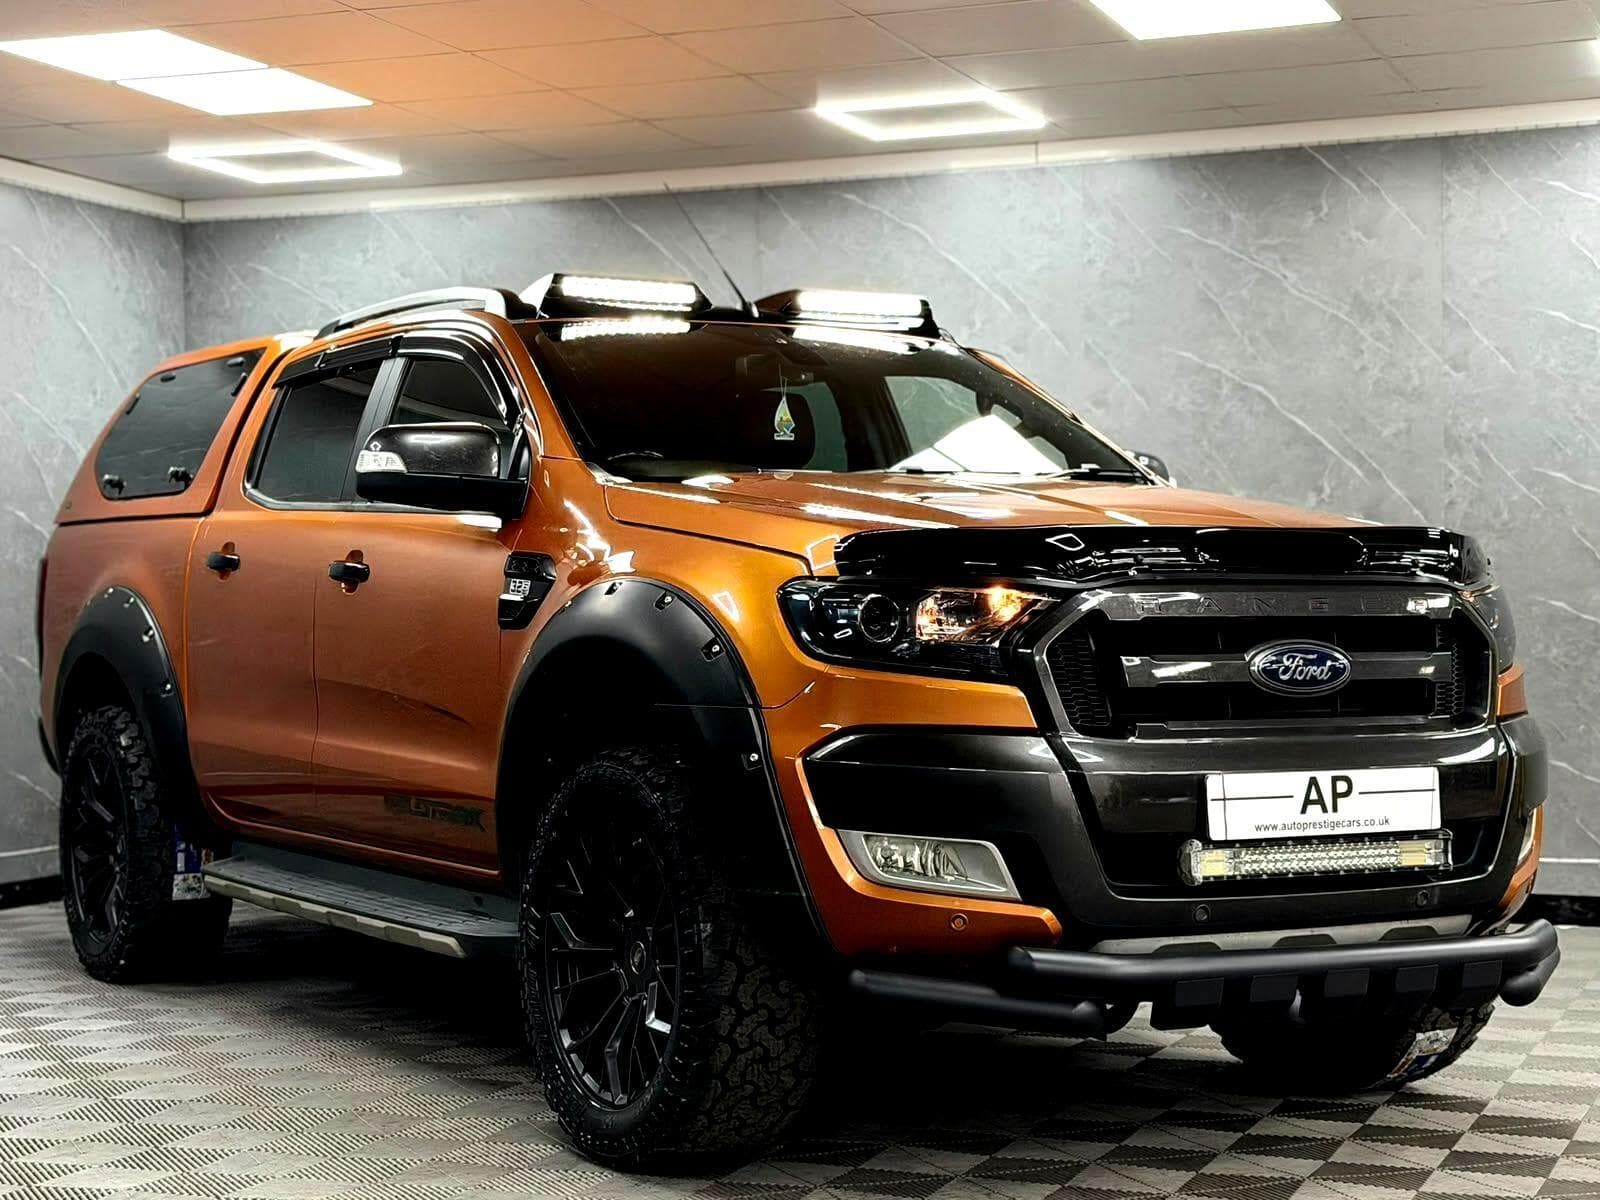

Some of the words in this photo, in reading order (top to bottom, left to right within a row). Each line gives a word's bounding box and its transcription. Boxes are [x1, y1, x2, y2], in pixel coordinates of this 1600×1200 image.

[1278, 653, 1331, 680] Ford
[1300, 775, 1353, 814] AP
[1254, 816, 1390, 832] www.autoprestigecars.co.uk
